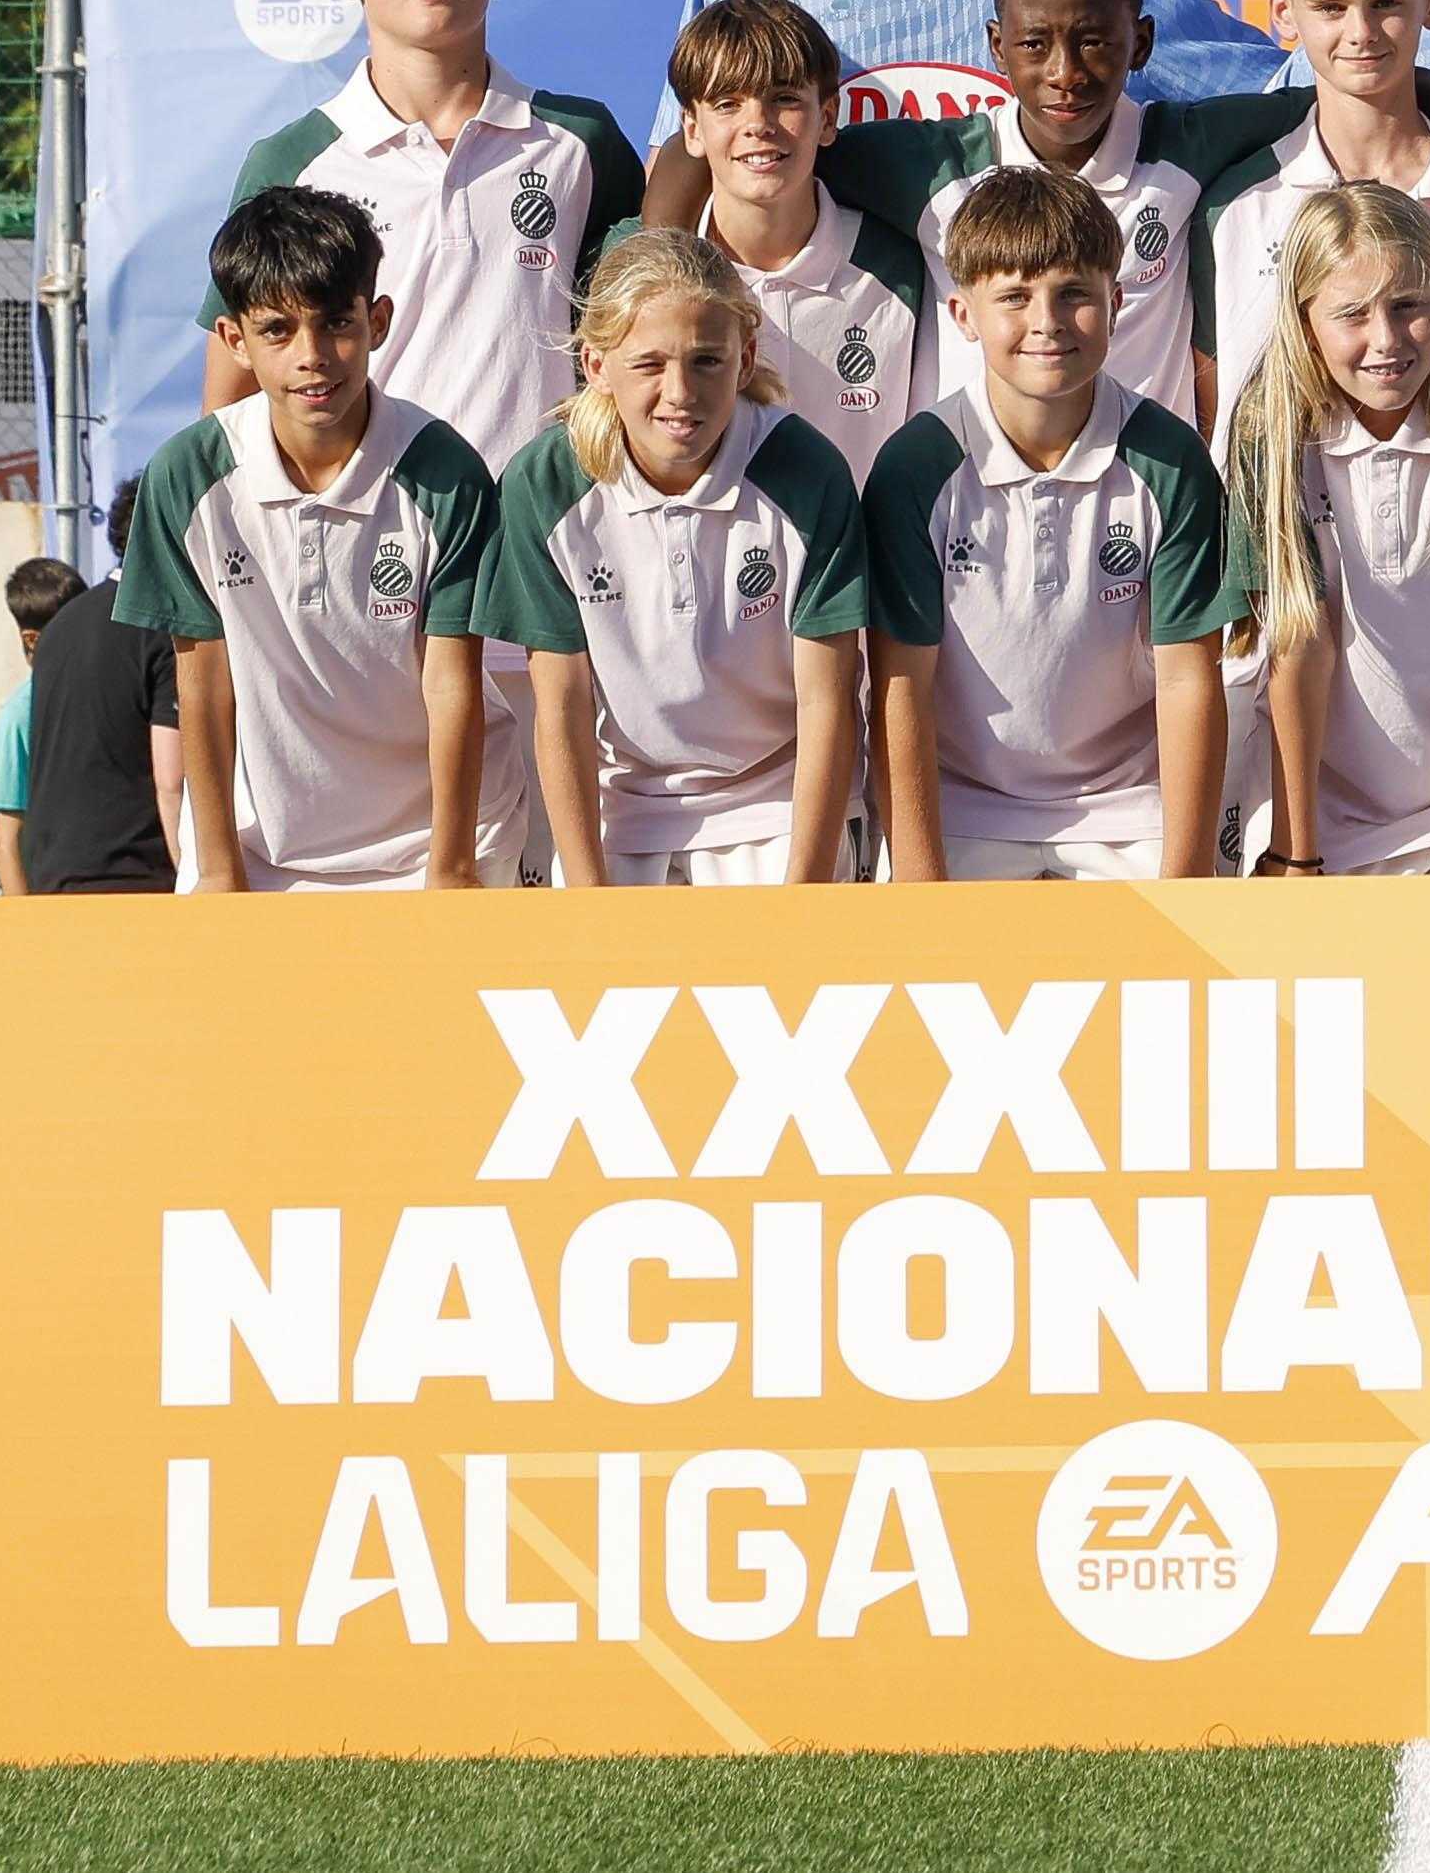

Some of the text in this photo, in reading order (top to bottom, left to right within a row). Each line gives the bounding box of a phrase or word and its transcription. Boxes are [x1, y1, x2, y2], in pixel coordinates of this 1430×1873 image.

[256, 4, 345, 27] SPORTS
[947, 564, 982, 574] ELME
[218, 576, 255, 589] KELME
[374, 602, 409, 617] DANI
[579, 592, 622, 604] KELME
[475, 977, 1367, 1180] XXXIII
[1079, 1474, 1233, 1551] EA
[167, 1448, 970, 1648] LALIGA
[1077, 1556, 1238, 1591] SPORTS
